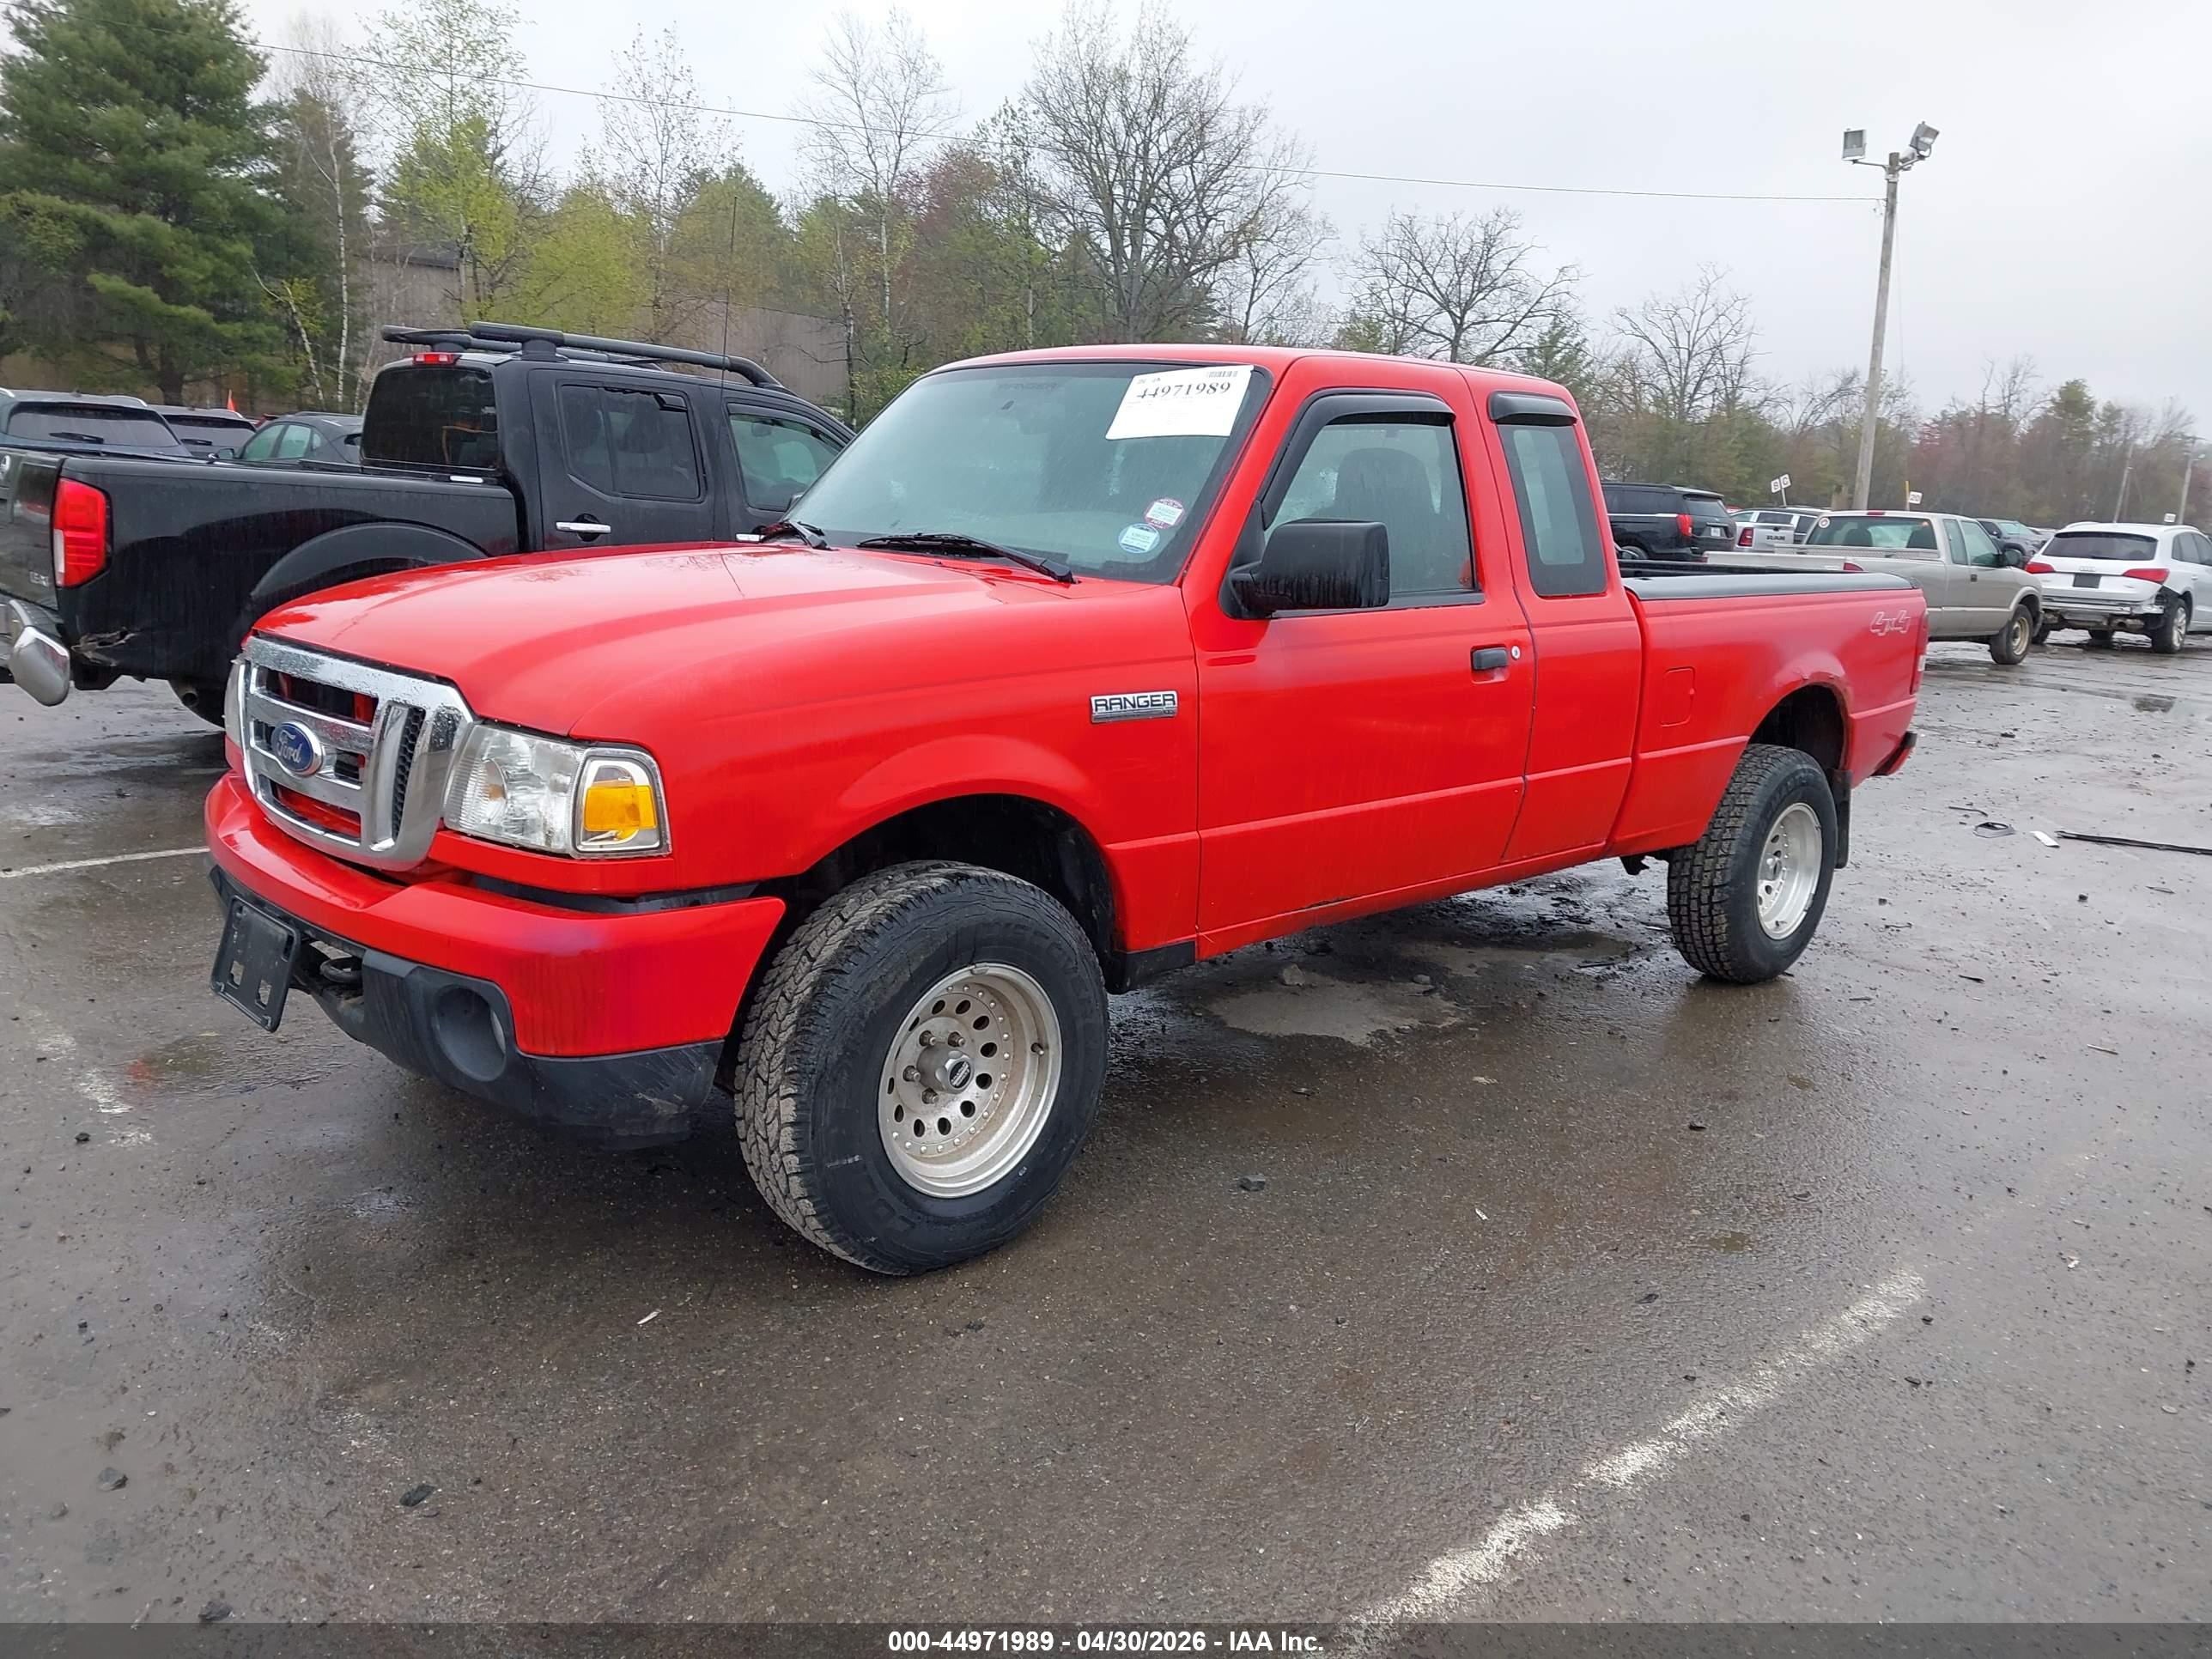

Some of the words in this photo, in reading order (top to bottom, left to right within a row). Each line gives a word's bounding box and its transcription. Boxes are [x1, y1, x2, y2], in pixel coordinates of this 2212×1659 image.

[1136, 381, 1231, 399] 44971989
[1094, 694, 1176, 712] RANGER
[276, 729, 303, 763] Ford
